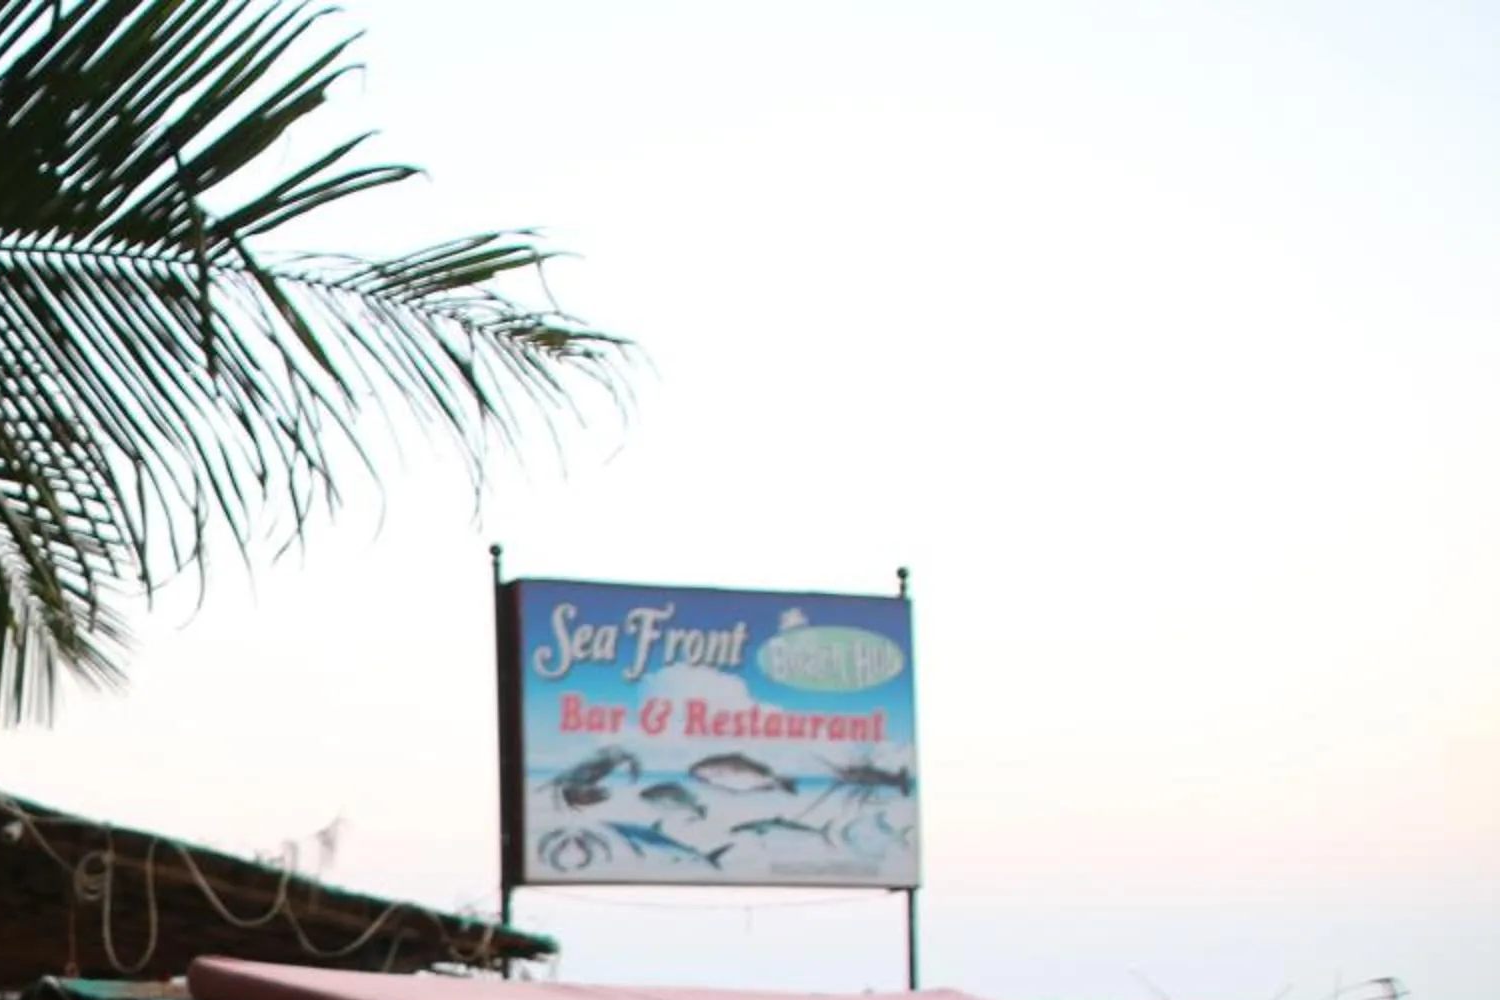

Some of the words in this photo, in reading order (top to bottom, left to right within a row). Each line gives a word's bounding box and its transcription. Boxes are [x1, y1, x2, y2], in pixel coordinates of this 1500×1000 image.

[533, 603, 618, 679] Sea
[622, 604, 748, 680] Front
[559, 693, 626, 735] Bar
[638, 697, 674, 737] &
[684, 699, 886, 742] Restaurant
